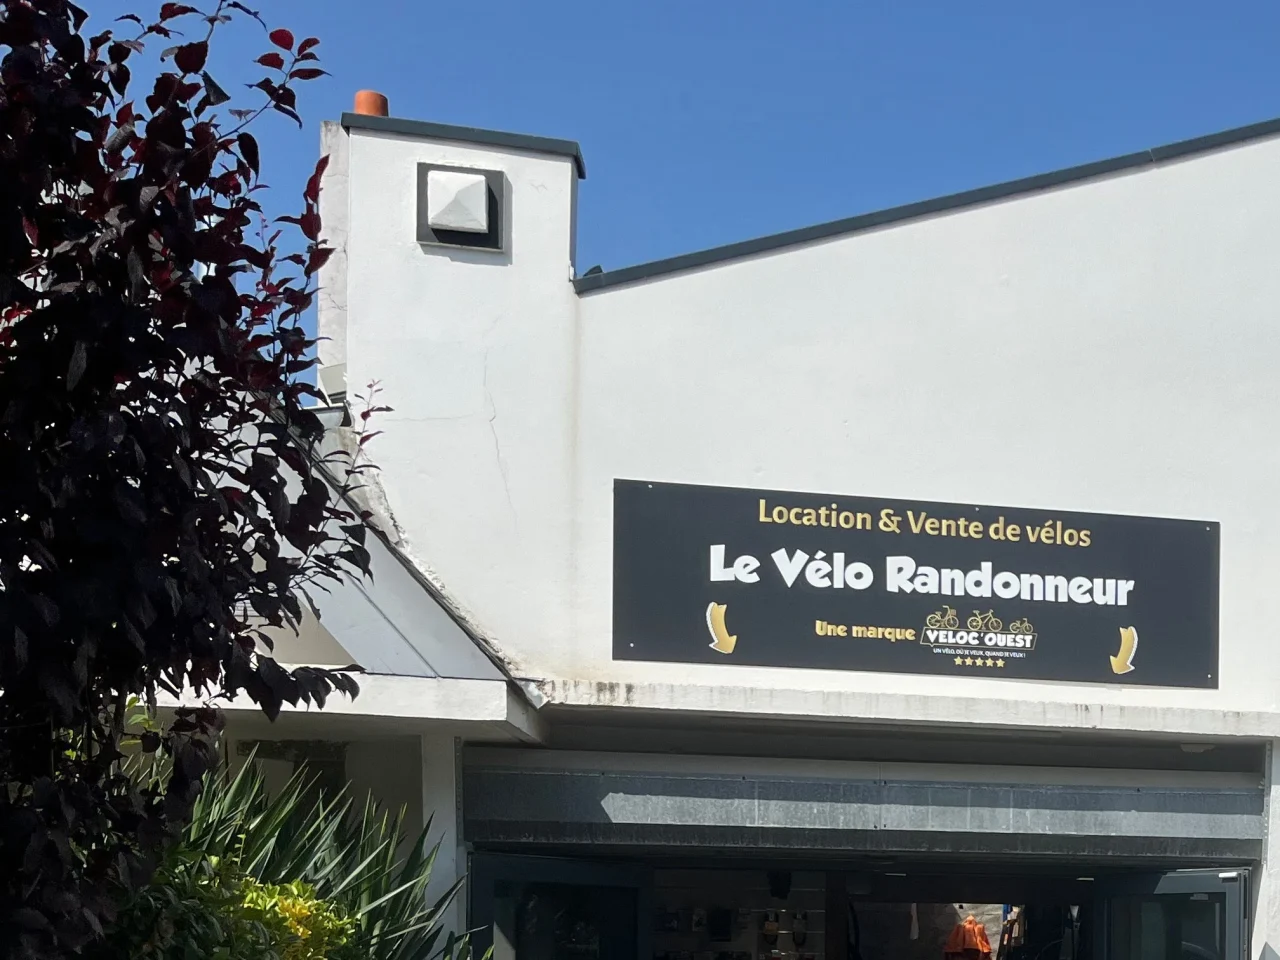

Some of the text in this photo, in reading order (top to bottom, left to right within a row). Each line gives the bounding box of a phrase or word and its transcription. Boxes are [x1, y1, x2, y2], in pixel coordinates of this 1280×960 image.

[758, 499, 1092, 547] Location & Vente de vélos
[709, 544, 1135, 606] Le Vélo Randonneur
[815, 619, 916, 644] Une marque
